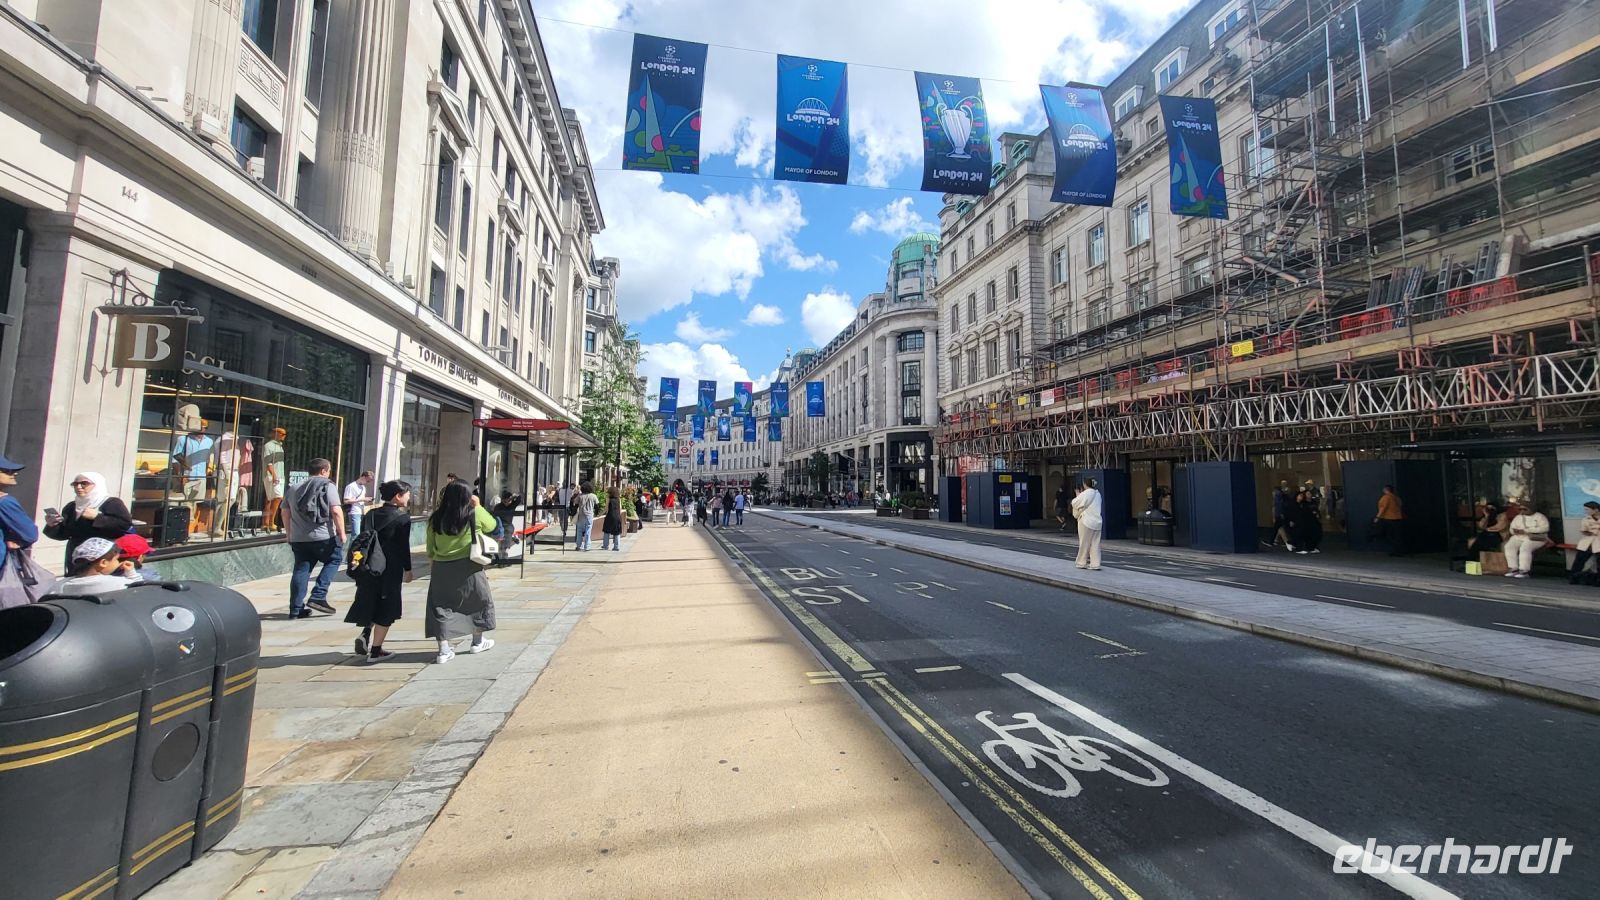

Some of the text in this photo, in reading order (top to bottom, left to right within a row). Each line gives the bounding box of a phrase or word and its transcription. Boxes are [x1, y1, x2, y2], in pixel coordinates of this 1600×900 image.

[681, 66, 696, 75] 24
[826, 117, 840, 126] 24
[1201, 123, 1212, 131] 24
[1096, 142, 1108, 150] 24
[784, 166, 805, 174] MAYOR
[970, 172, 983, 181] 24
[121, 185, 138, 203] 144
[128, 322, 171, 362] B
[418, 345, 449, 371] TOMMY
